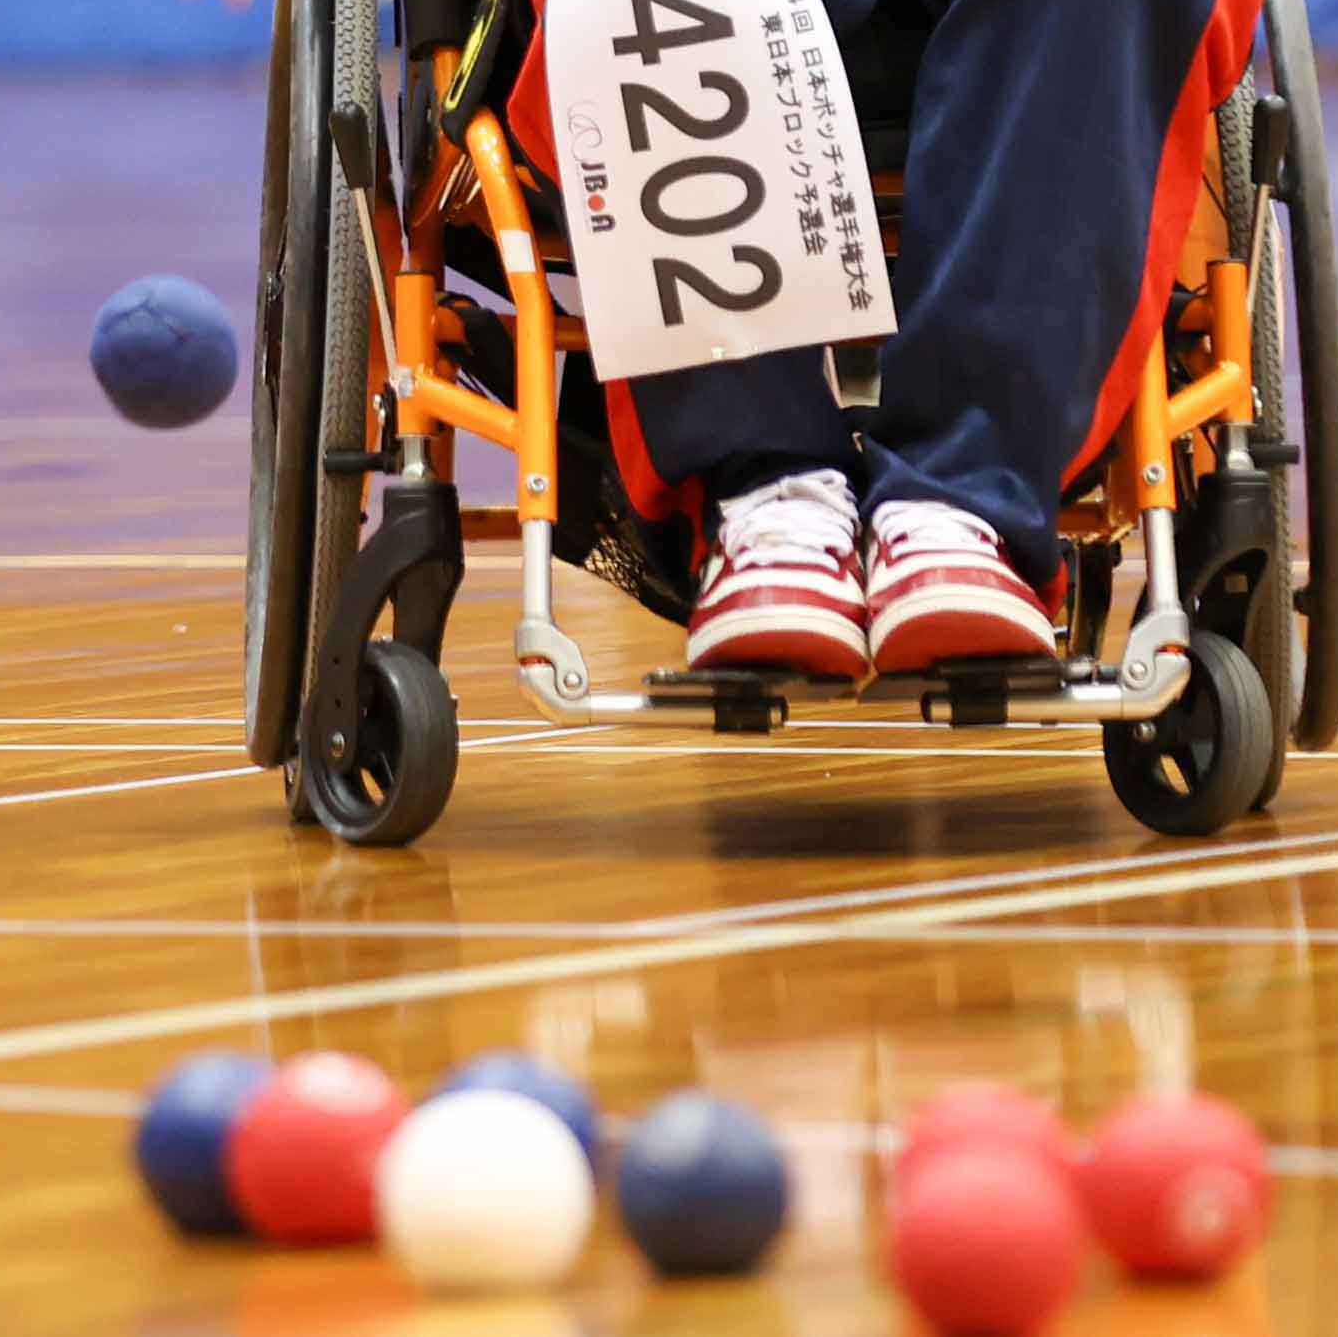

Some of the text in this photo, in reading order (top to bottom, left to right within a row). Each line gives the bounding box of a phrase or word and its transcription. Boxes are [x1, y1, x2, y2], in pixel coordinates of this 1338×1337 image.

[760, 11, 828, 256] 東日本ブロック予選会
